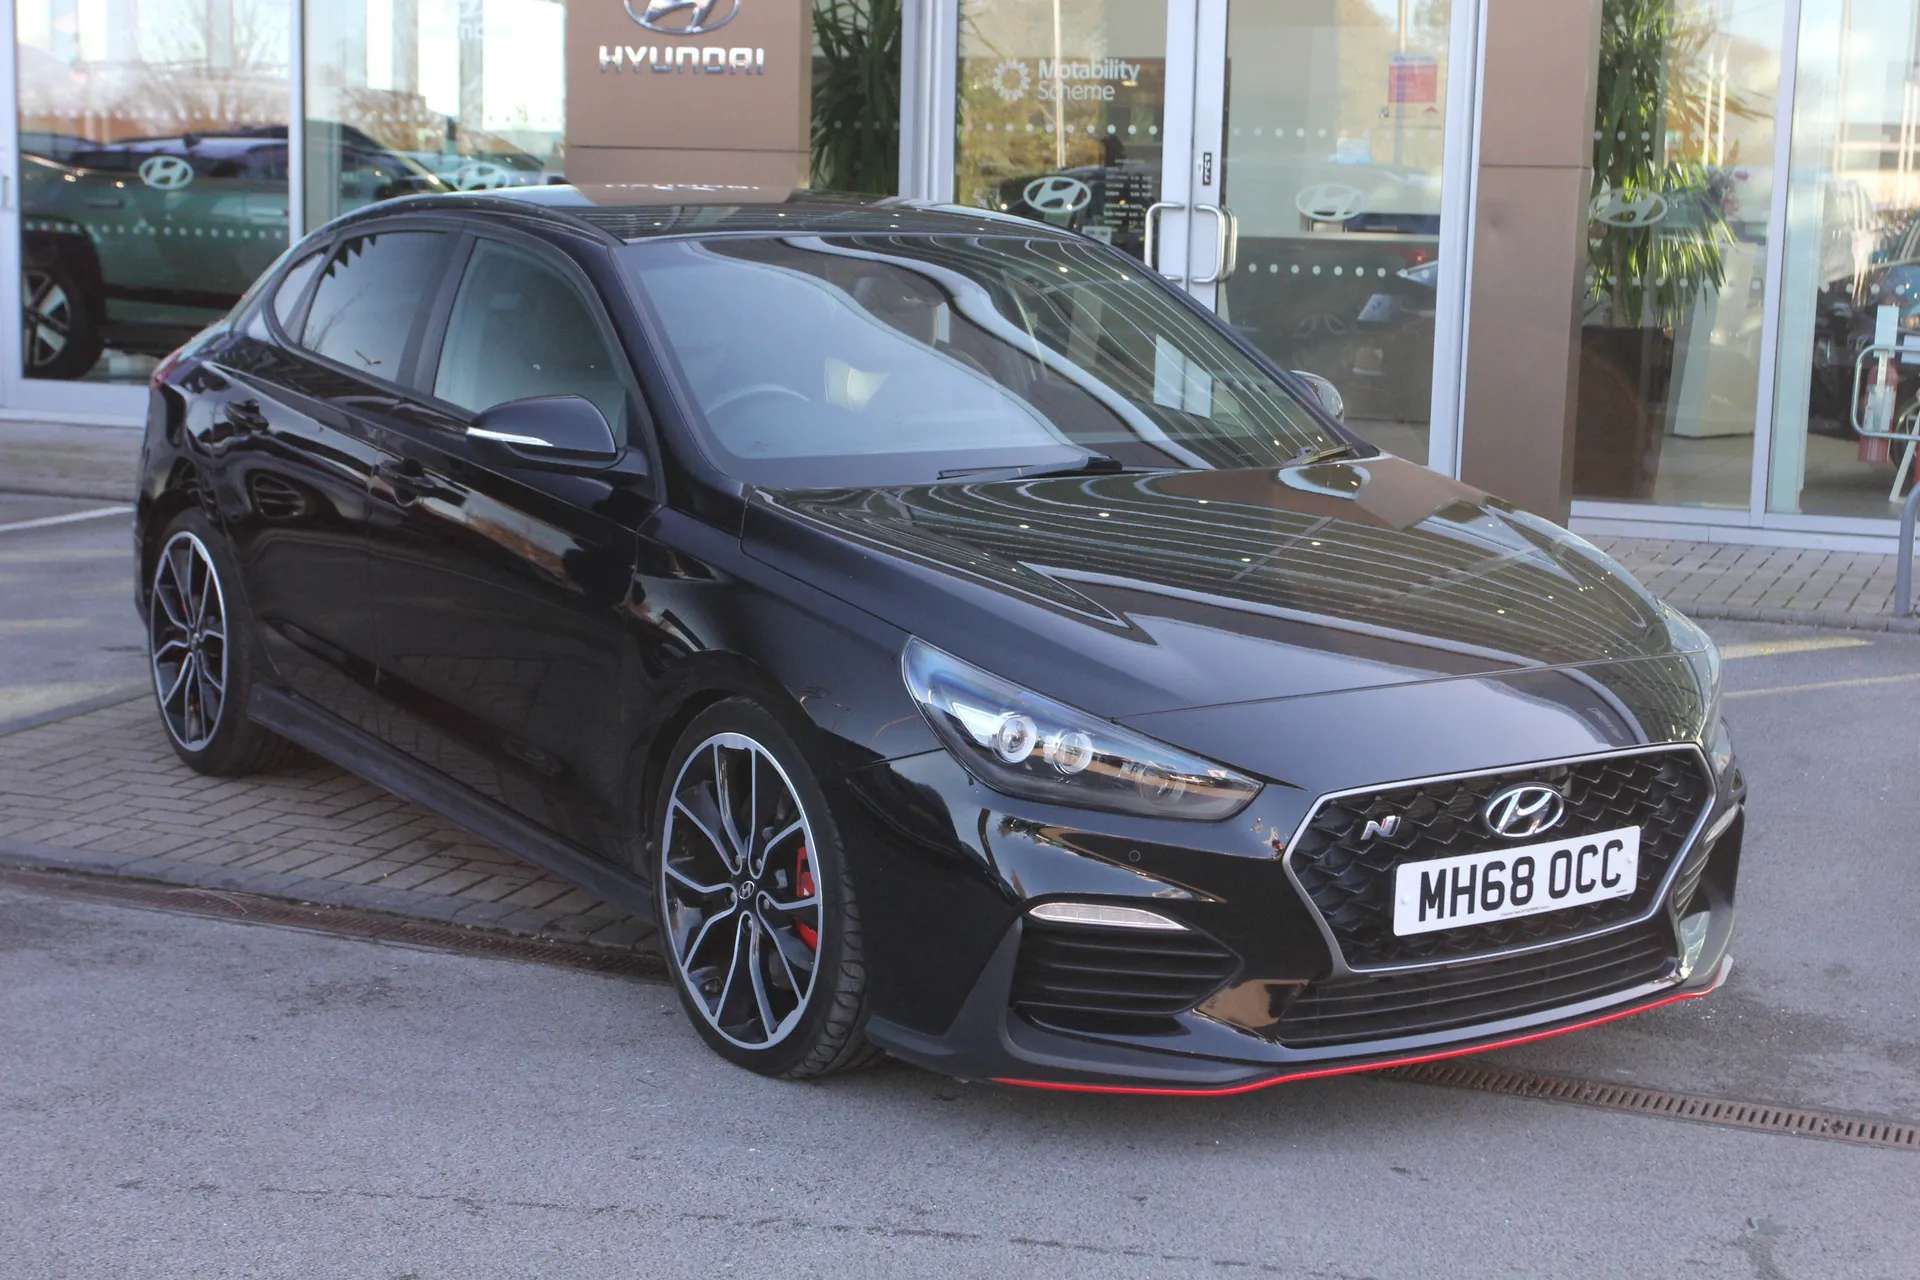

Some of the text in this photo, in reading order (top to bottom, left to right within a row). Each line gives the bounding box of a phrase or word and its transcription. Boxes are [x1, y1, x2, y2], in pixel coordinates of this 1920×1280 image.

[598, 45, 766, 75] HYUNDAI
[1038, 58, 1141, 83] Motability
[1038, 79, 1116, 101] Scheme
[1360, 815, 1401, 841] N
[1418, 839, 1624, 922] MH68 OCC
